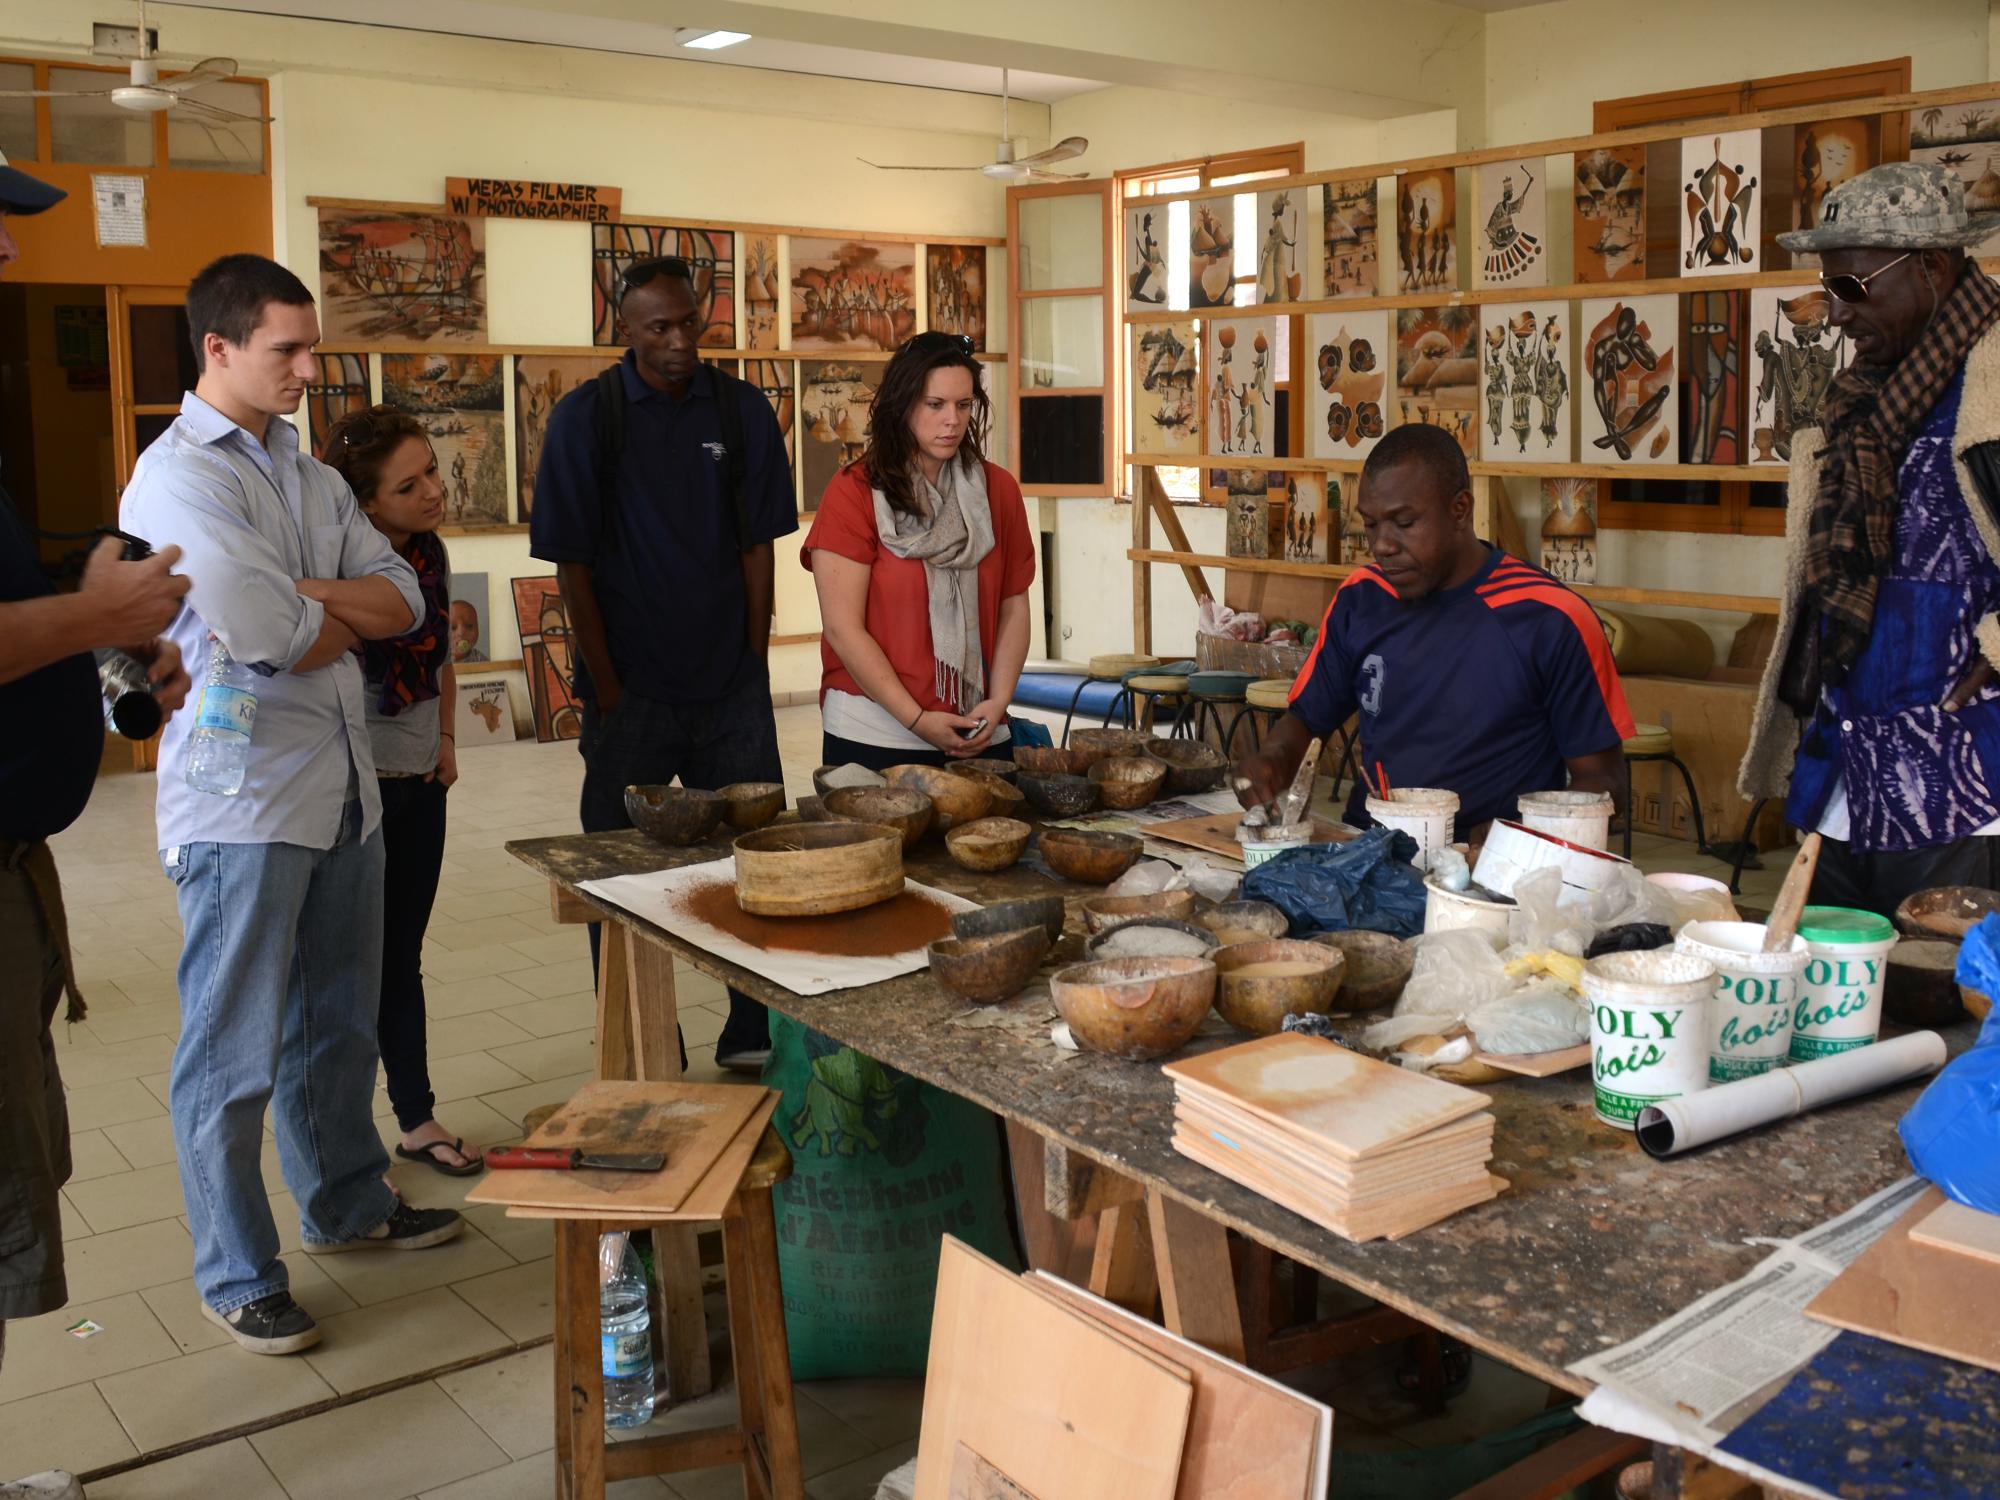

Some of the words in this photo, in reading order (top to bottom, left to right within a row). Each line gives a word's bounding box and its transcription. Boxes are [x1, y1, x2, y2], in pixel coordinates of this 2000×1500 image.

[477, 199, 609, 221] PHOTOGRAPHIER
[530, 182, 597, 202] FILMER
[1361, 653, 1386, 716] 3
[1804, 957, 1882, 987] OLY
[1793, 988, 1871, 1032] bois
[1719, 1007, 1789, 1051] bois
[1595, 1044, 1666, 1080] bois
